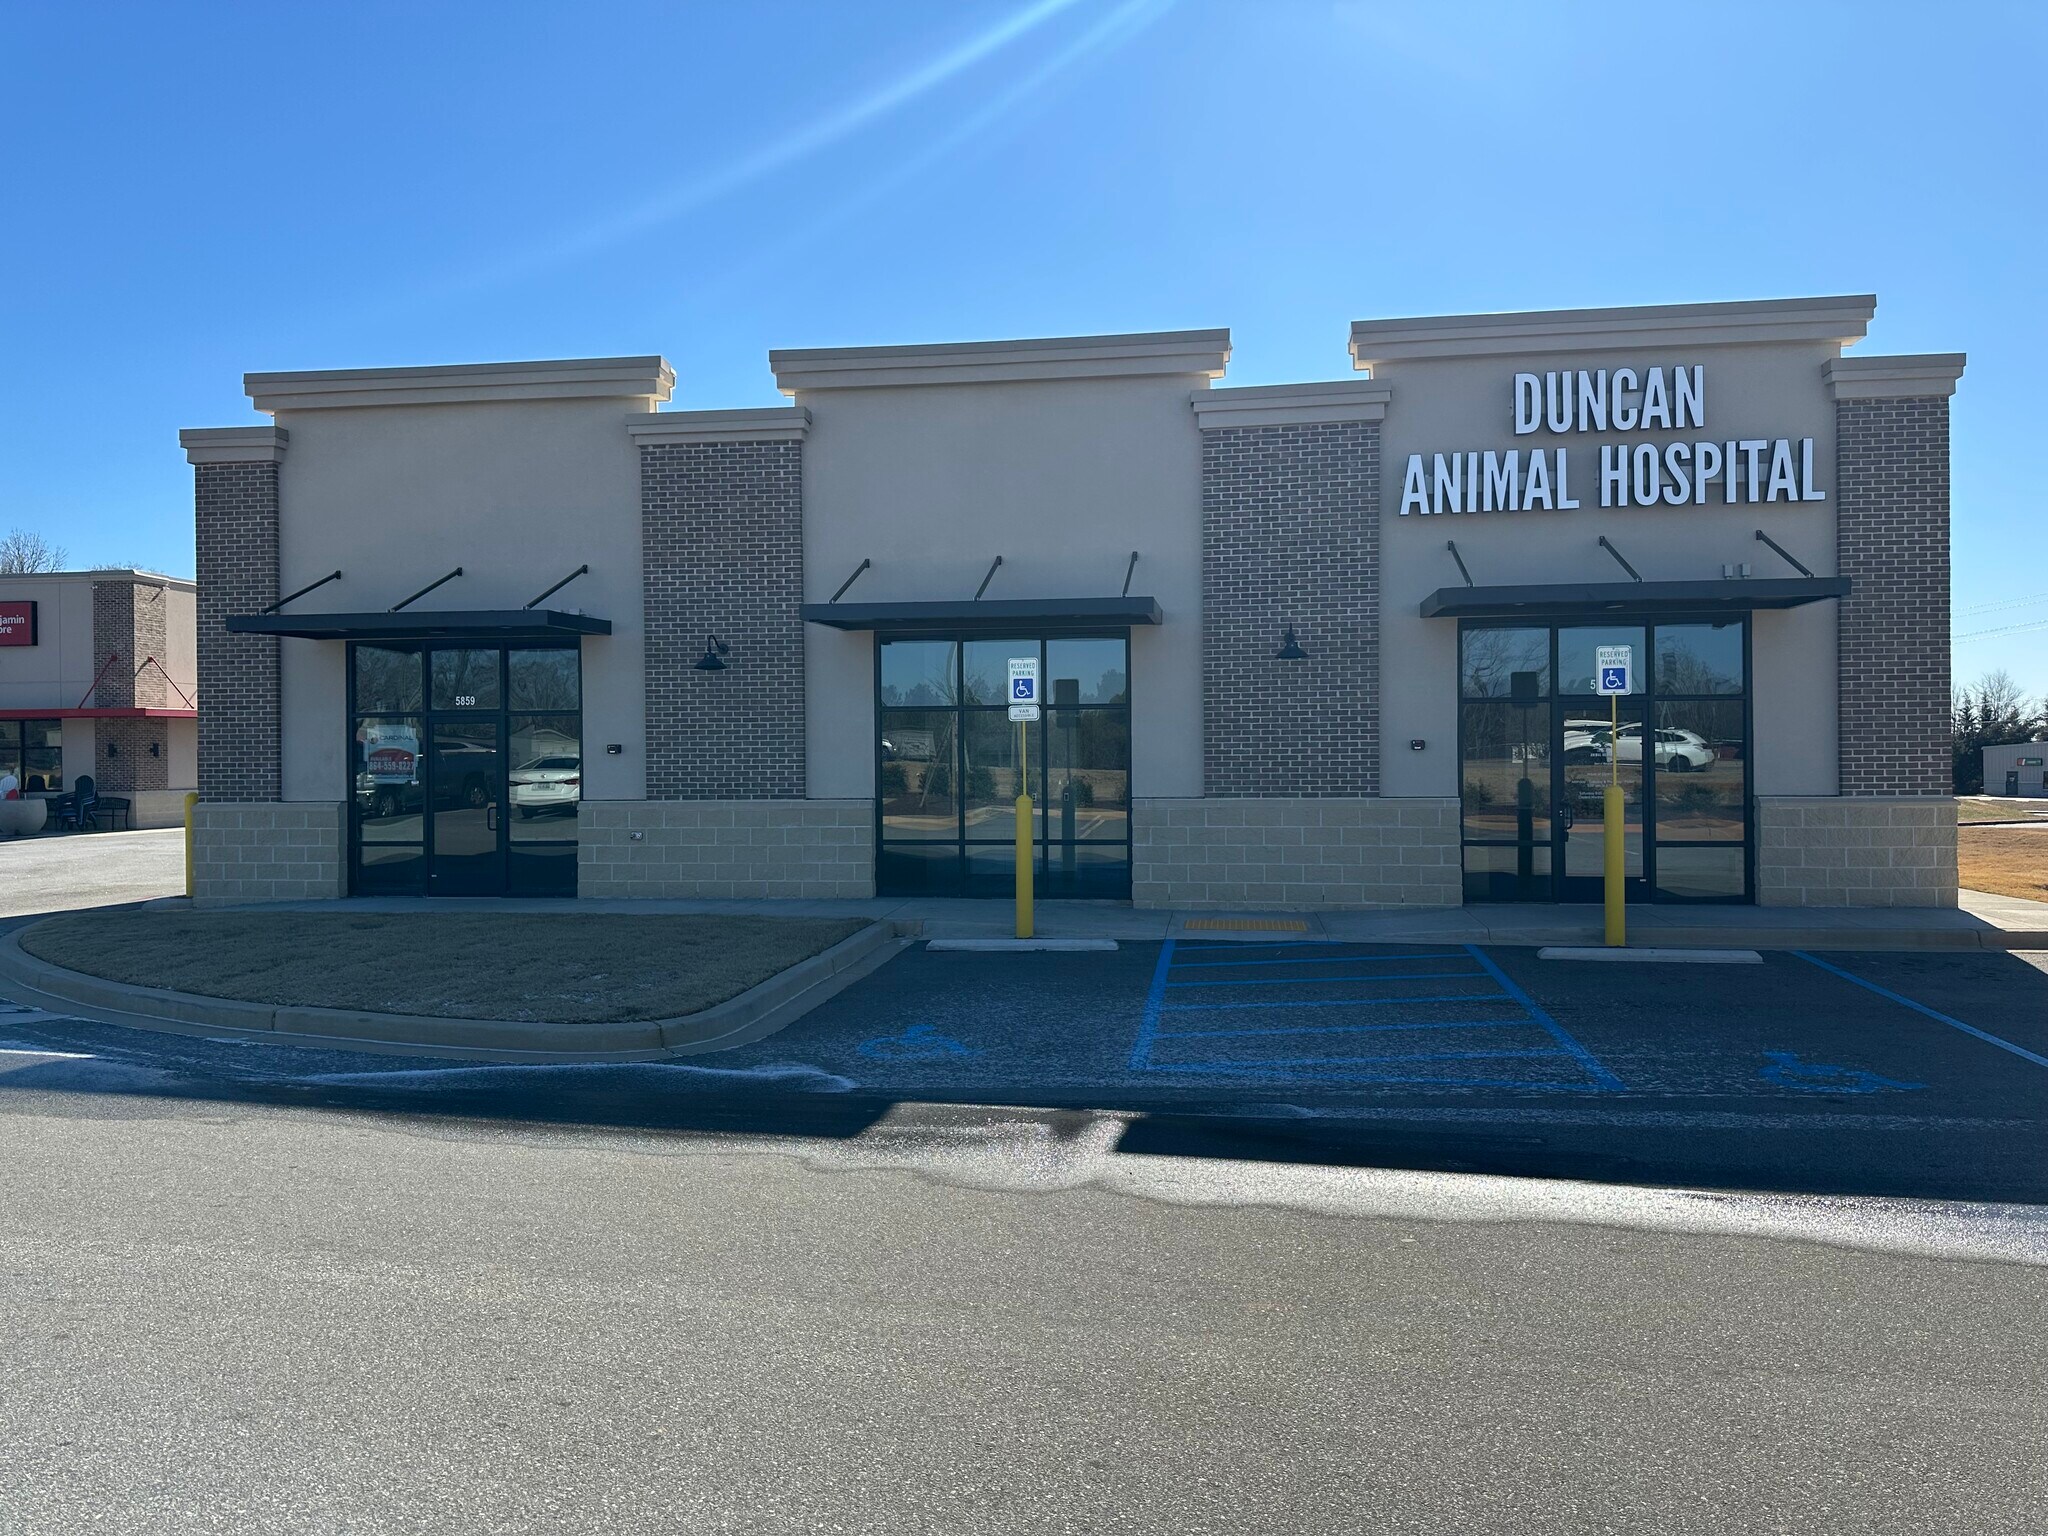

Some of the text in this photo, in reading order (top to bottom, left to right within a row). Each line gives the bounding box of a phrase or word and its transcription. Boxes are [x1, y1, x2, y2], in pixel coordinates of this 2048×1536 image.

[1513, 365, 1705, 436] DUNCAN
[1400, 438, 1826, 516] ANIMAL HOSPITAL
[455, 695, 476, 706] 5859
